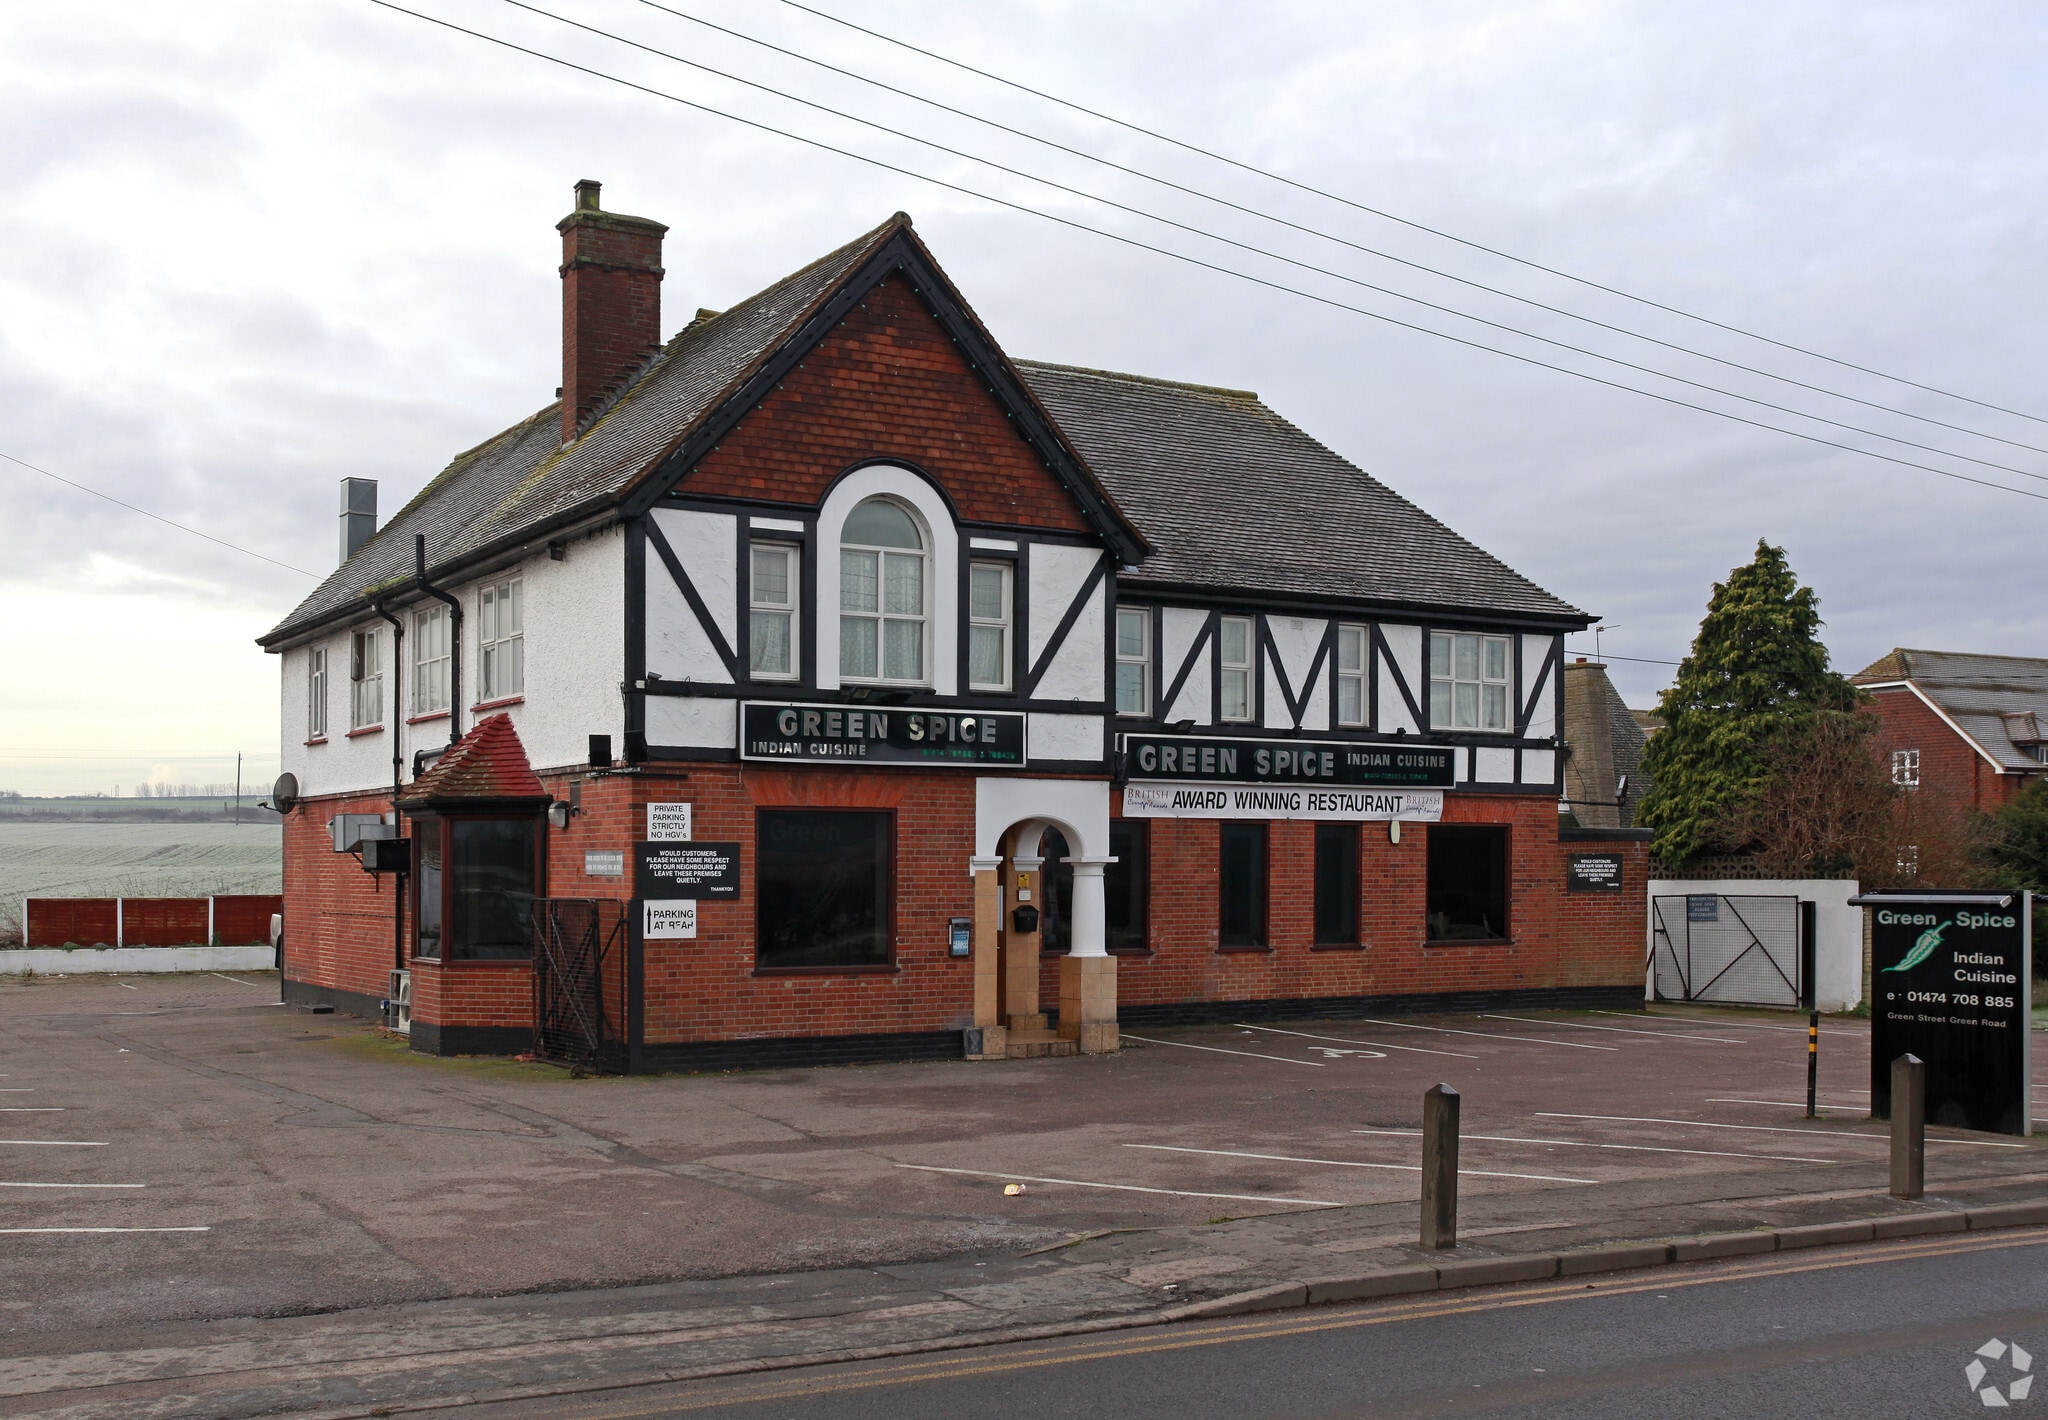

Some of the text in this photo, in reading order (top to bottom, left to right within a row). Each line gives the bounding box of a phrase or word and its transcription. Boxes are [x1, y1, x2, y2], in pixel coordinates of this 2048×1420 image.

[777, 709, 997, 743] GREEN SPICE
[752, 741, 866, 756] INDIAN CUISINE
[1137, 745, 1446, 777] GREEN SPICE INDIAN CUISINE
[1127, 788, 1169, 799] BRITISH
[1406, 794, 1440, 805] BRITISH
[654, 805, 683, 813] PRIVATE
[1171, 791, 1403, 813] AWARD WINNING RESTAURANT
[652, 813, 685, 821] PARKING
[651, 822, 687, 830] STRICTLY
[653, 909, 694, 918] PARKING
[1877, 910, 2016, 929] Green Spice
[654, 921, 665, 930] AT
[1953, 951, 2004, 965] Indian
[1954, 969, 2017, 984] Cuisine
[1907, 991, 1947, 1003] 01474
[1951, 994, 1979, 1005] 708
[1984, 996, 2014, 1007] 885
[1887, 1012, 2007, 1028] Green Street Green Road
